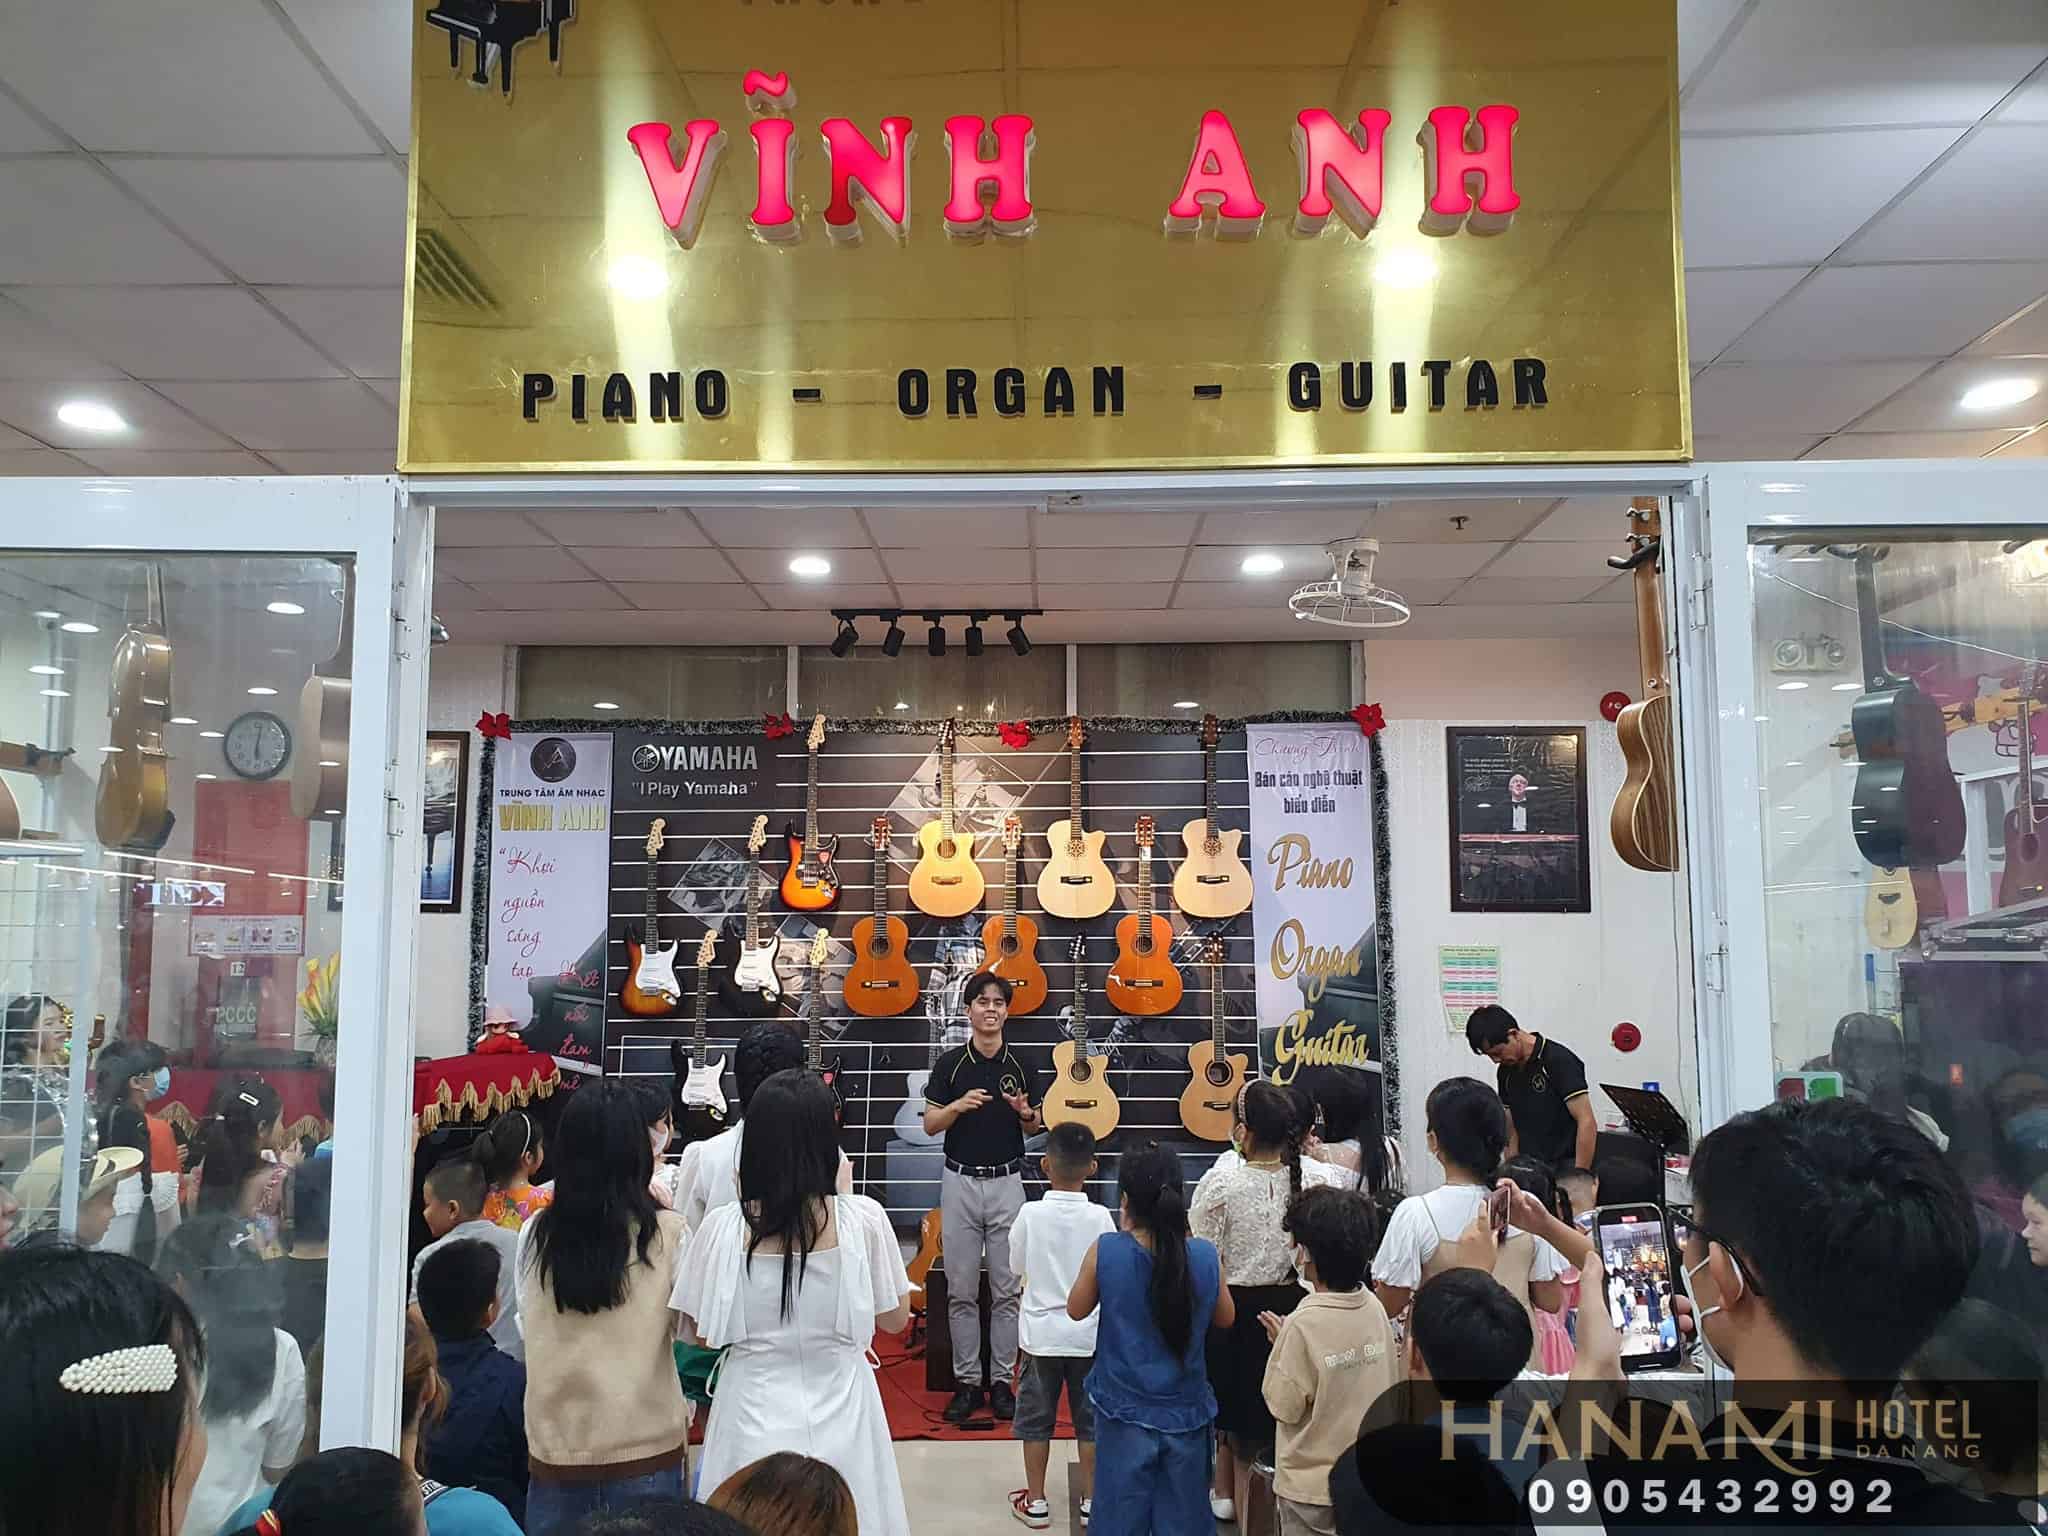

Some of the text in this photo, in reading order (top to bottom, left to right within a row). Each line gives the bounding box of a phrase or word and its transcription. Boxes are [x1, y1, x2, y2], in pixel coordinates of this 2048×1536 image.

[628, 70, 1520, 240] VĨNH ANH
[522, 369, 729, 422] PIANO
[897, 366, 1125, 418] ORGAN
[1287, 357, 1550, 412] GUITAR
[660, 745, 759, 771] YAMAHA
[647, 781, 680, 799] Play
[1303, 770, 1331, 790] nghệ
[1333, 769, 1363, 789] thuật
[500, 787, 606, 801] TRUNG TÂM ÂM NHẠC
[1284, 793, 1336, 814] biểu diễn
[559, 804, 606, 831] ANH
[1268, 833, 1353, 891] Piano
[1271, 918, 1363, 1003] Organ
[1272, 1010, 1369, 1086] Guitar
